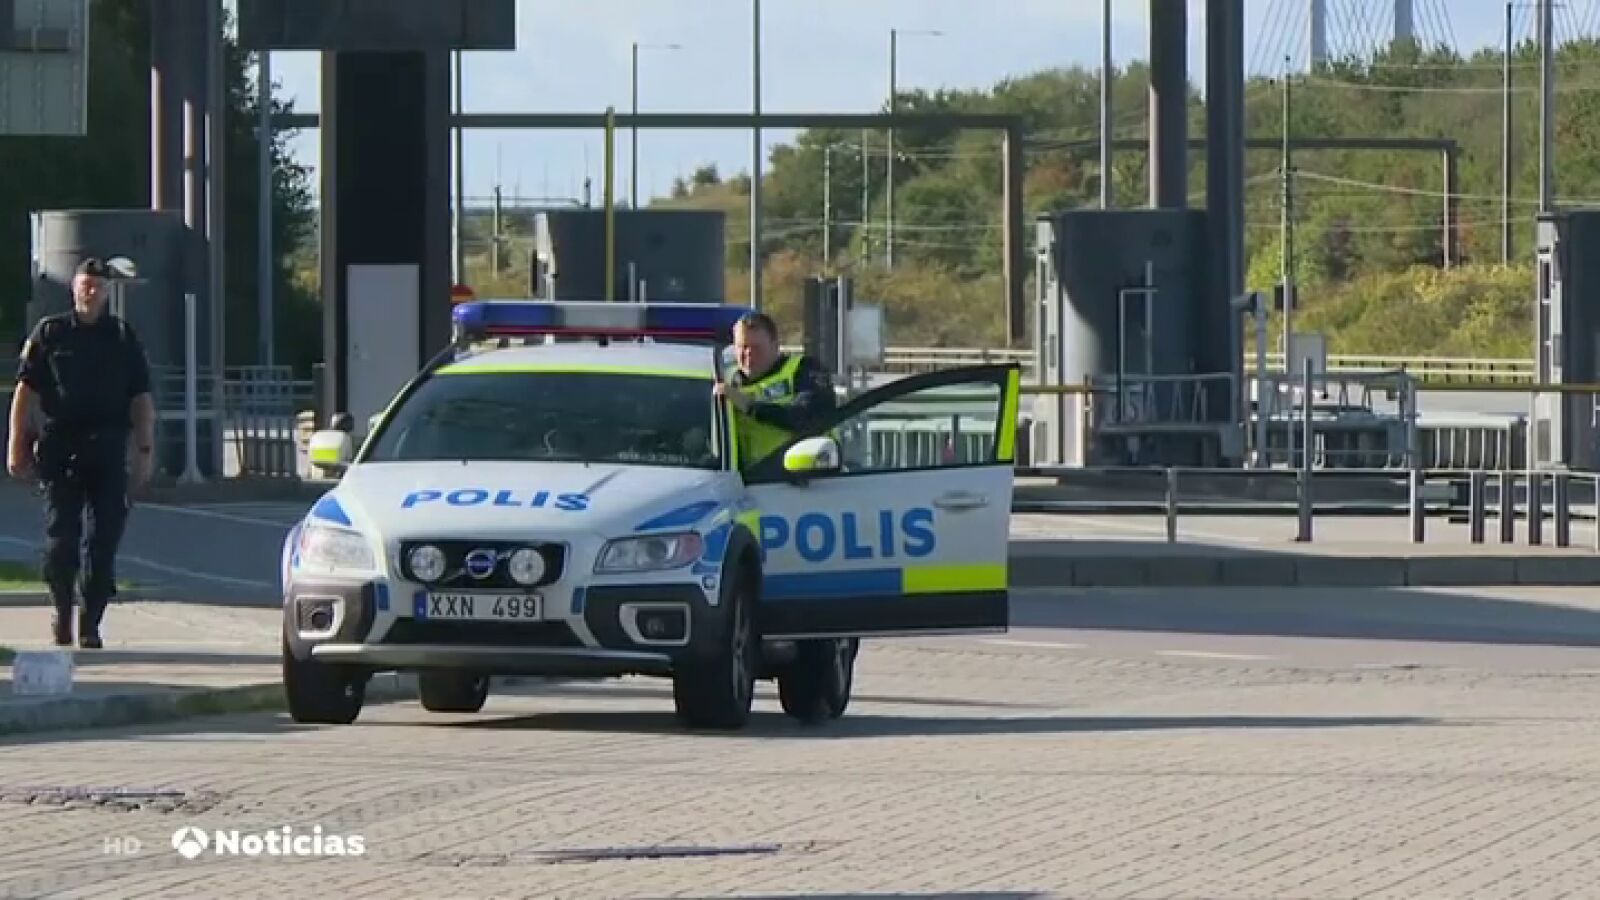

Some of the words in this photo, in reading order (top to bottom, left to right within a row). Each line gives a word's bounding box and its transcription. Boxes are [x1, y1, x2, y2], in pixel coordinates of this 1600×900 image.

[401, 489, 591, 511] POLIS
[759, 507, 936, 564] POLIS
[430, 596, 473, 616] XXN
[492, 596, 536, 618] 499
